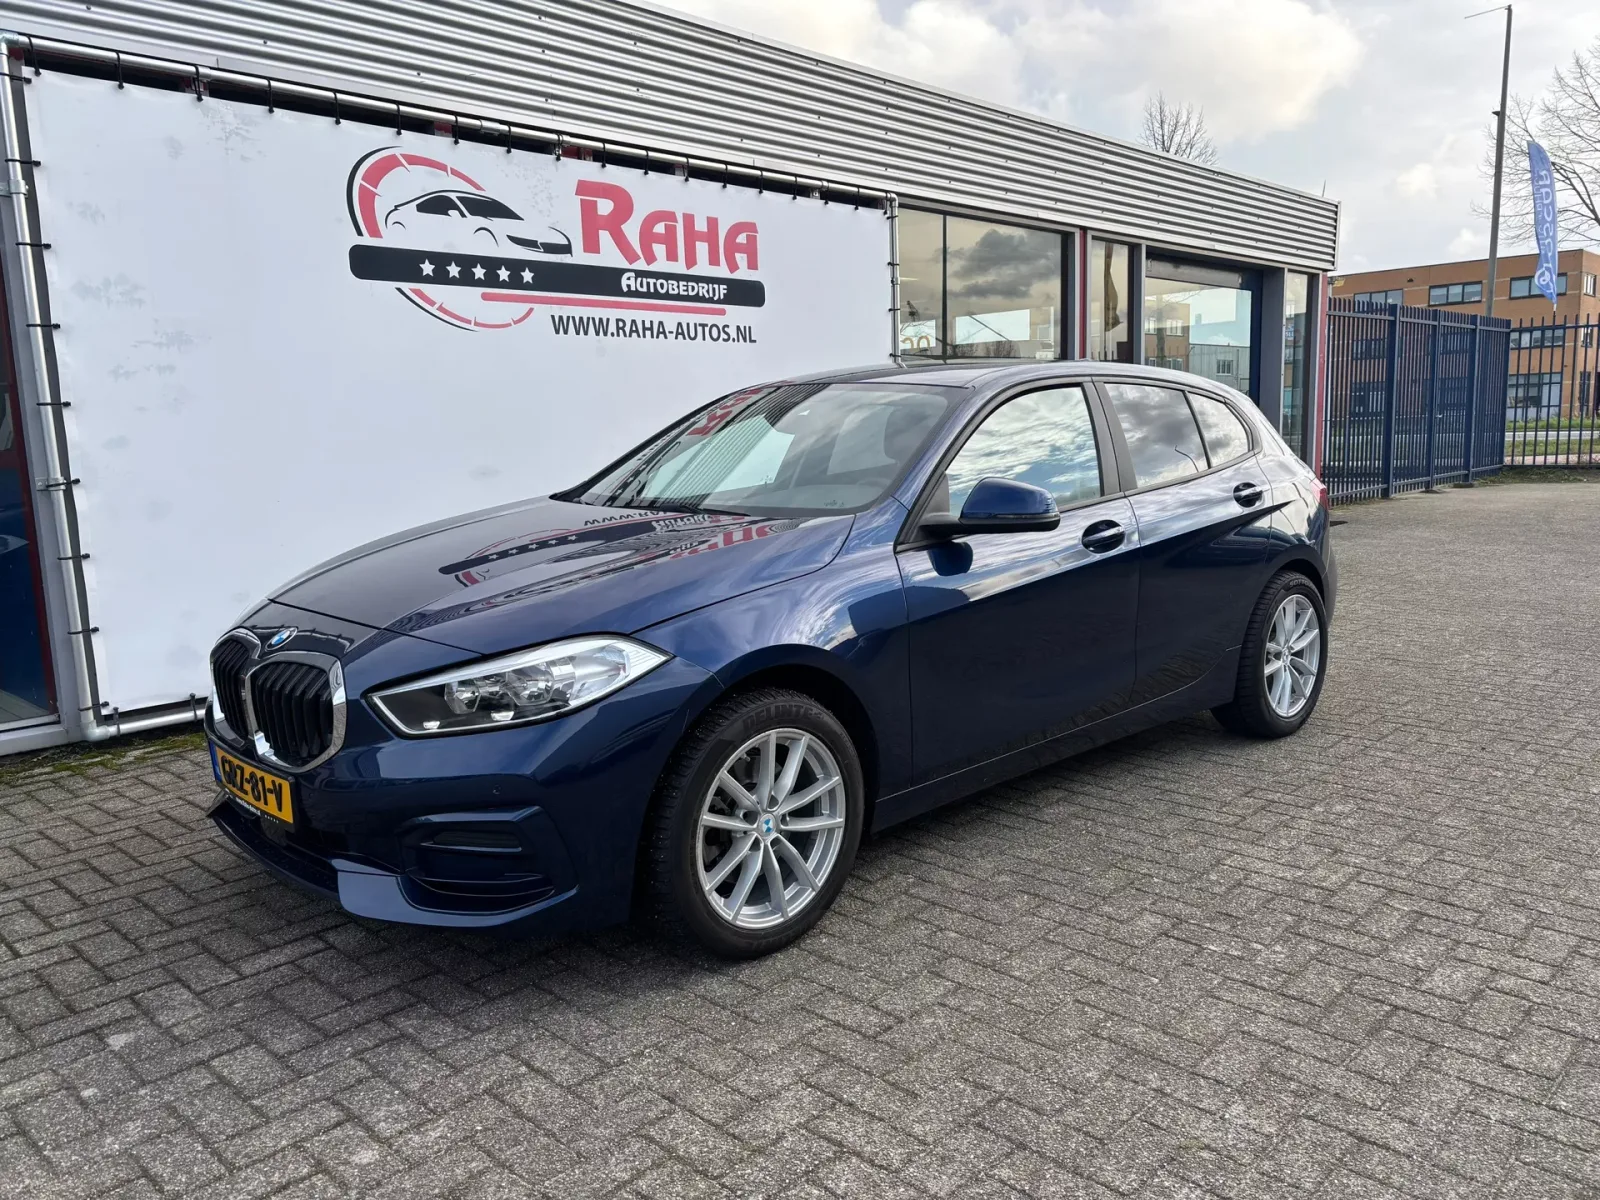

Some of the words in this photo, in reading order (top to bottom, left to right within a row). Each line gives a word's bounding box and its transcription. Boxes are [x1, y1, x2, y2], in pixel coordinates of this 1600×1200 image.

[575, 179, 759, 274] RAHA
[620, 271, 728, 300] AUTOBEDRIJF
[550, 314, 757, 344] WWW.RAHA-AUTOS.NL
